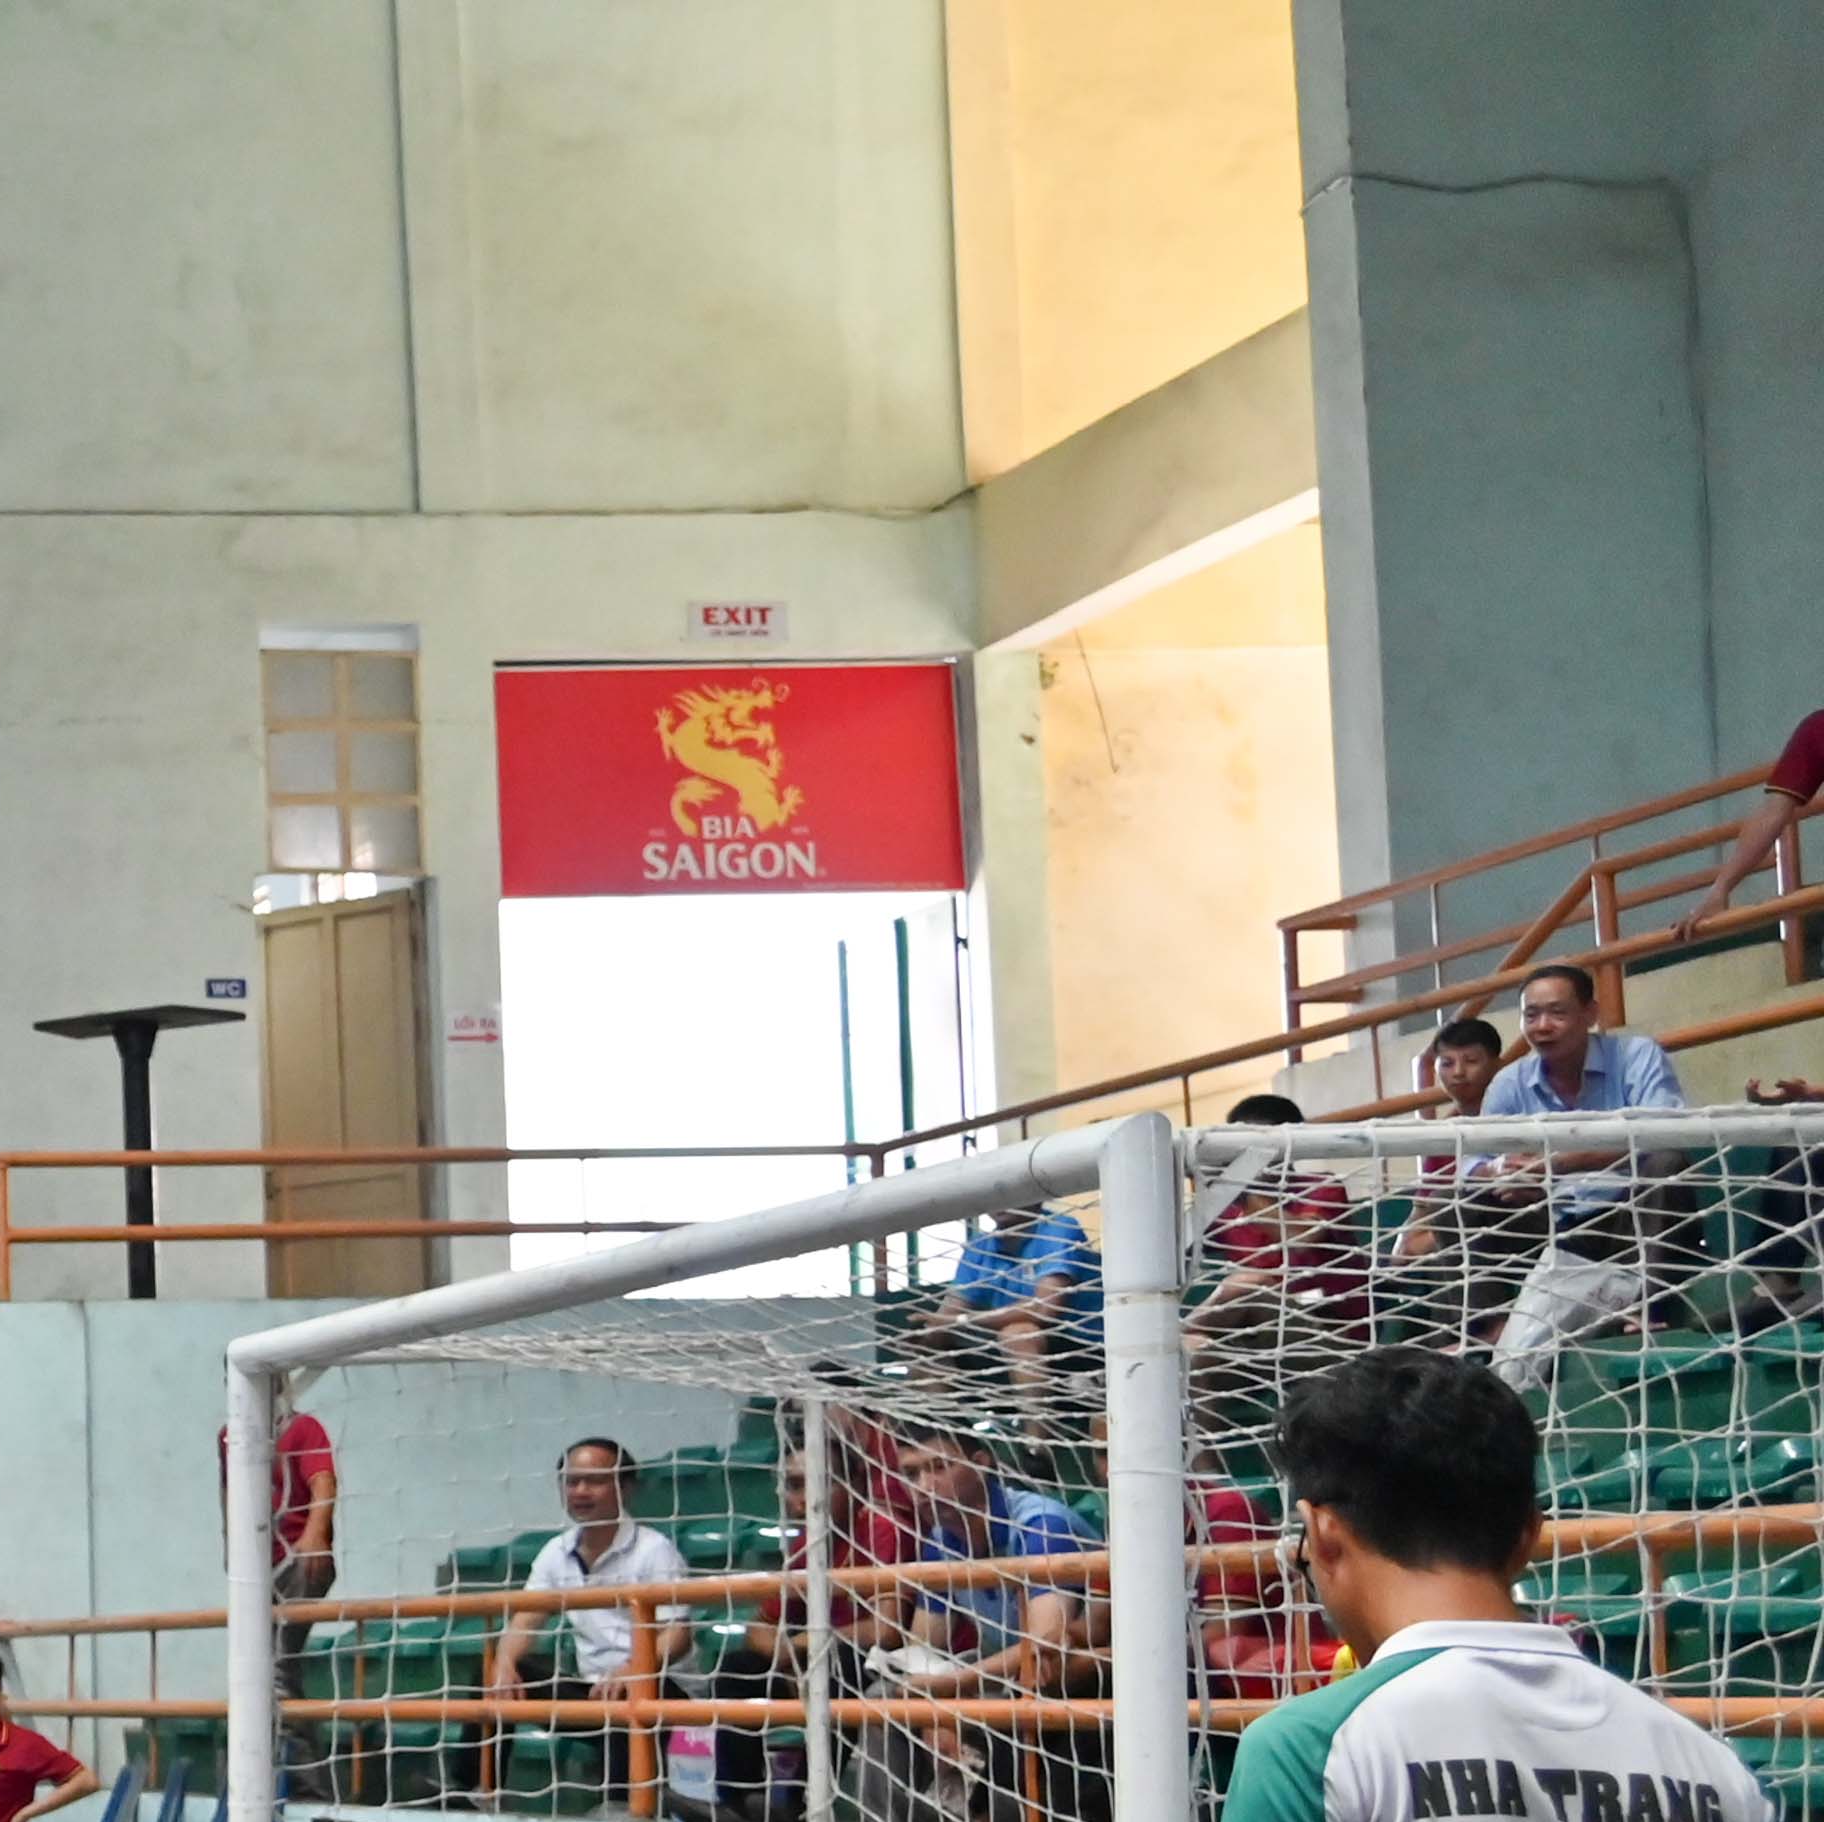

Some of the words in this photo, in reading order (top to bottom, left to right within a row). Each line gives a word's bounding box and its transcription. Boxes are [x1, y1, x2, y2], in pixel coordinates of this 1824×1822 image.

[703, 607, 773, 625] EXIT
[702, 816, 755, 839] BIA
[642, 842, 817, 880] SAIGON
[210, 982, 241, 996] WC
[1406, 1760, 1529, 1819] NHA
